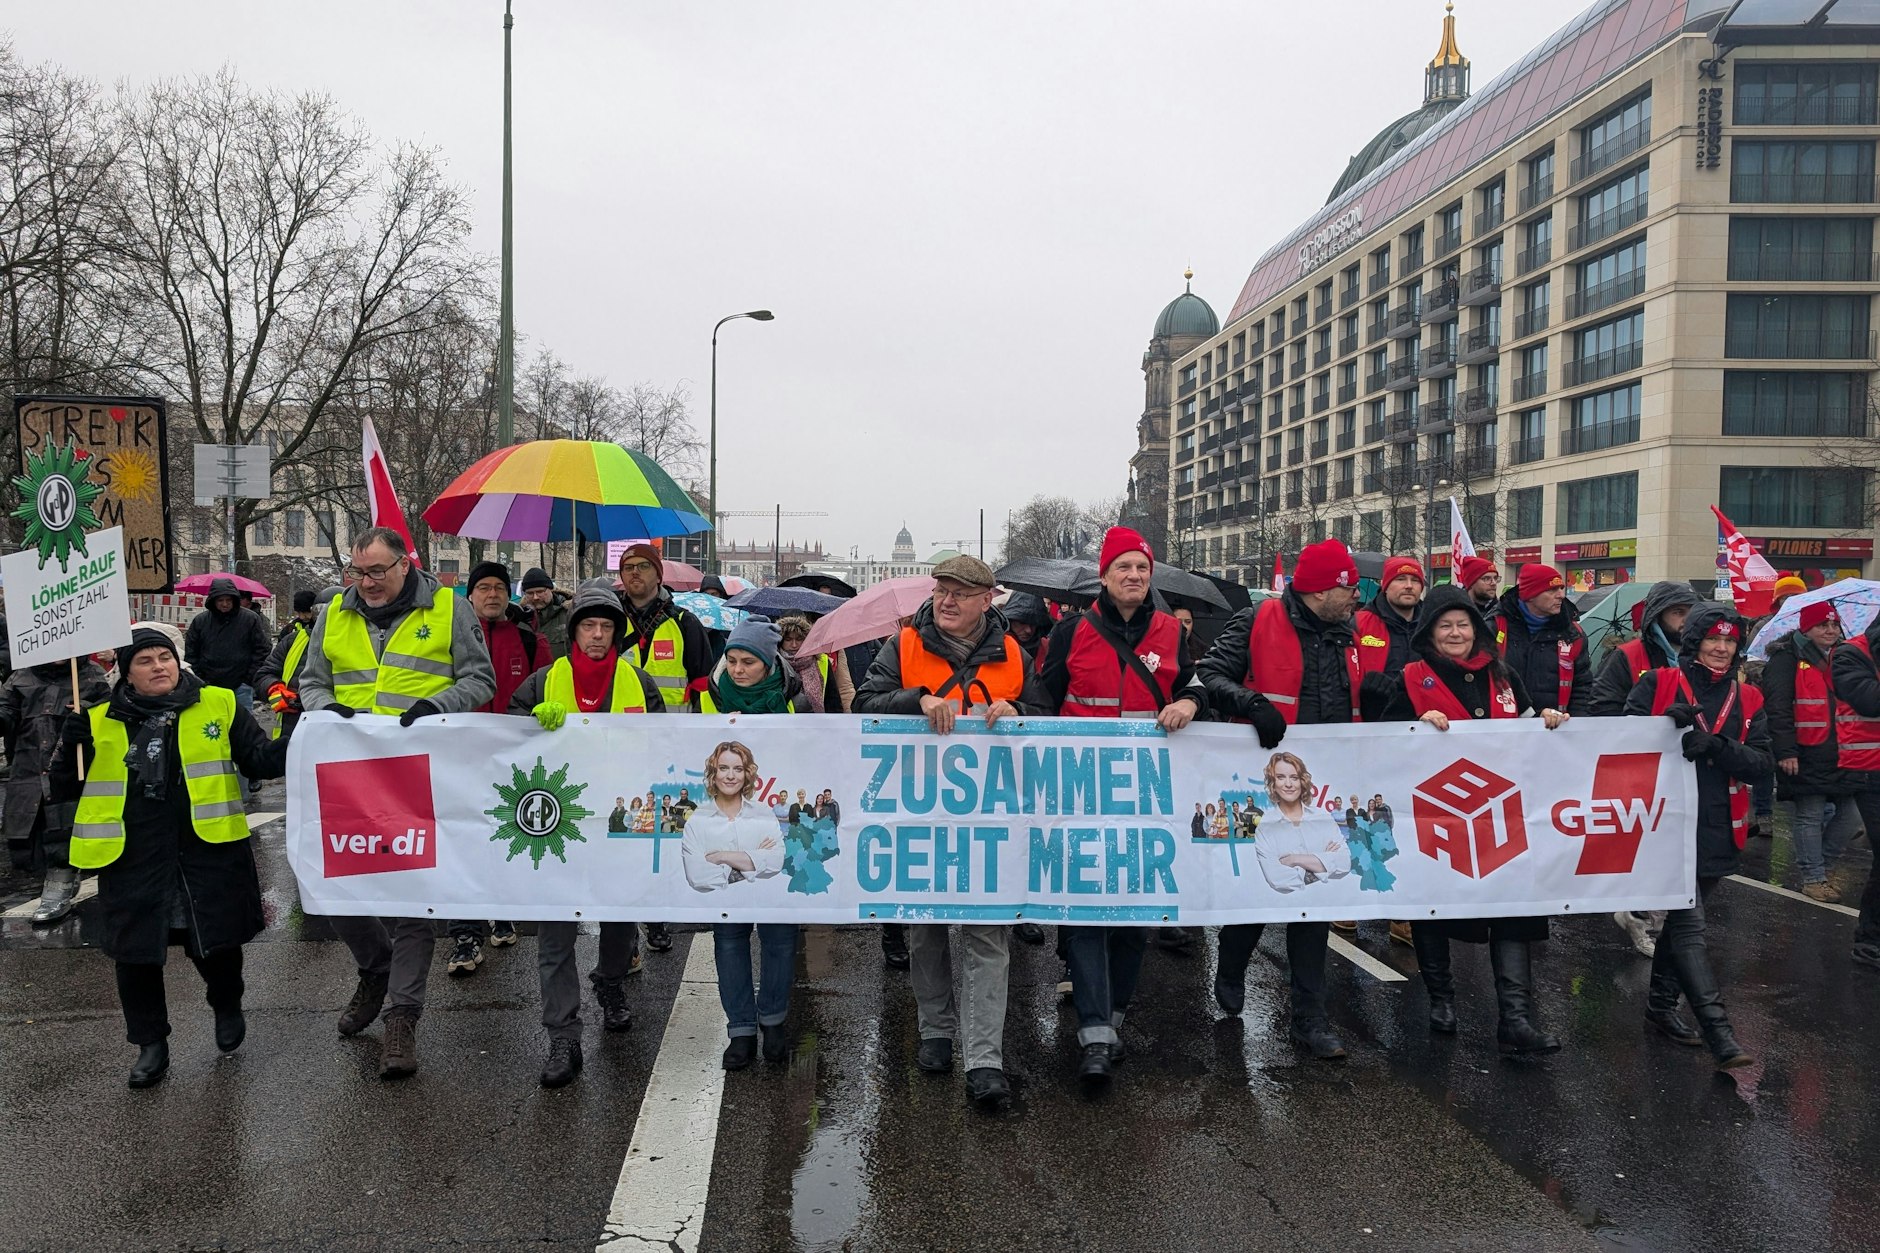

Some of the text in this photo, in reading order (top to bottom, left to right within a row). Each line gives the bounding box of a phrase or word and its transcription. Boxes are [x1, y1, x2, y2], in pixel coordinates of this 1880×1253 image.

[1696, 88, 1707, 168] COLLECTION
[1706, 88, 1723, 168] RADISSON
[1314, 203, 1364, 251] RADISSON
[1314, 226, 1363, 266] COLLECTION
[23, 406, 153, 448] STREIK
[1579, 543, 1608, 558] PYLONES
[1768, 540, 1823, 556] PYLONES
[32, 550, 116, 611] LÖHNE RAUF
[18, 615, 85, 656] ICH DRAUF.
[860, 744, 1174, 816] ZUSAMMEN
[523, 796, 554, 829] GdP
[1551, 797, 1667, 837] GEW
[329, 828, 426, 856] ver.di
[856, 825, 1180, 894] GEHT MEHR
